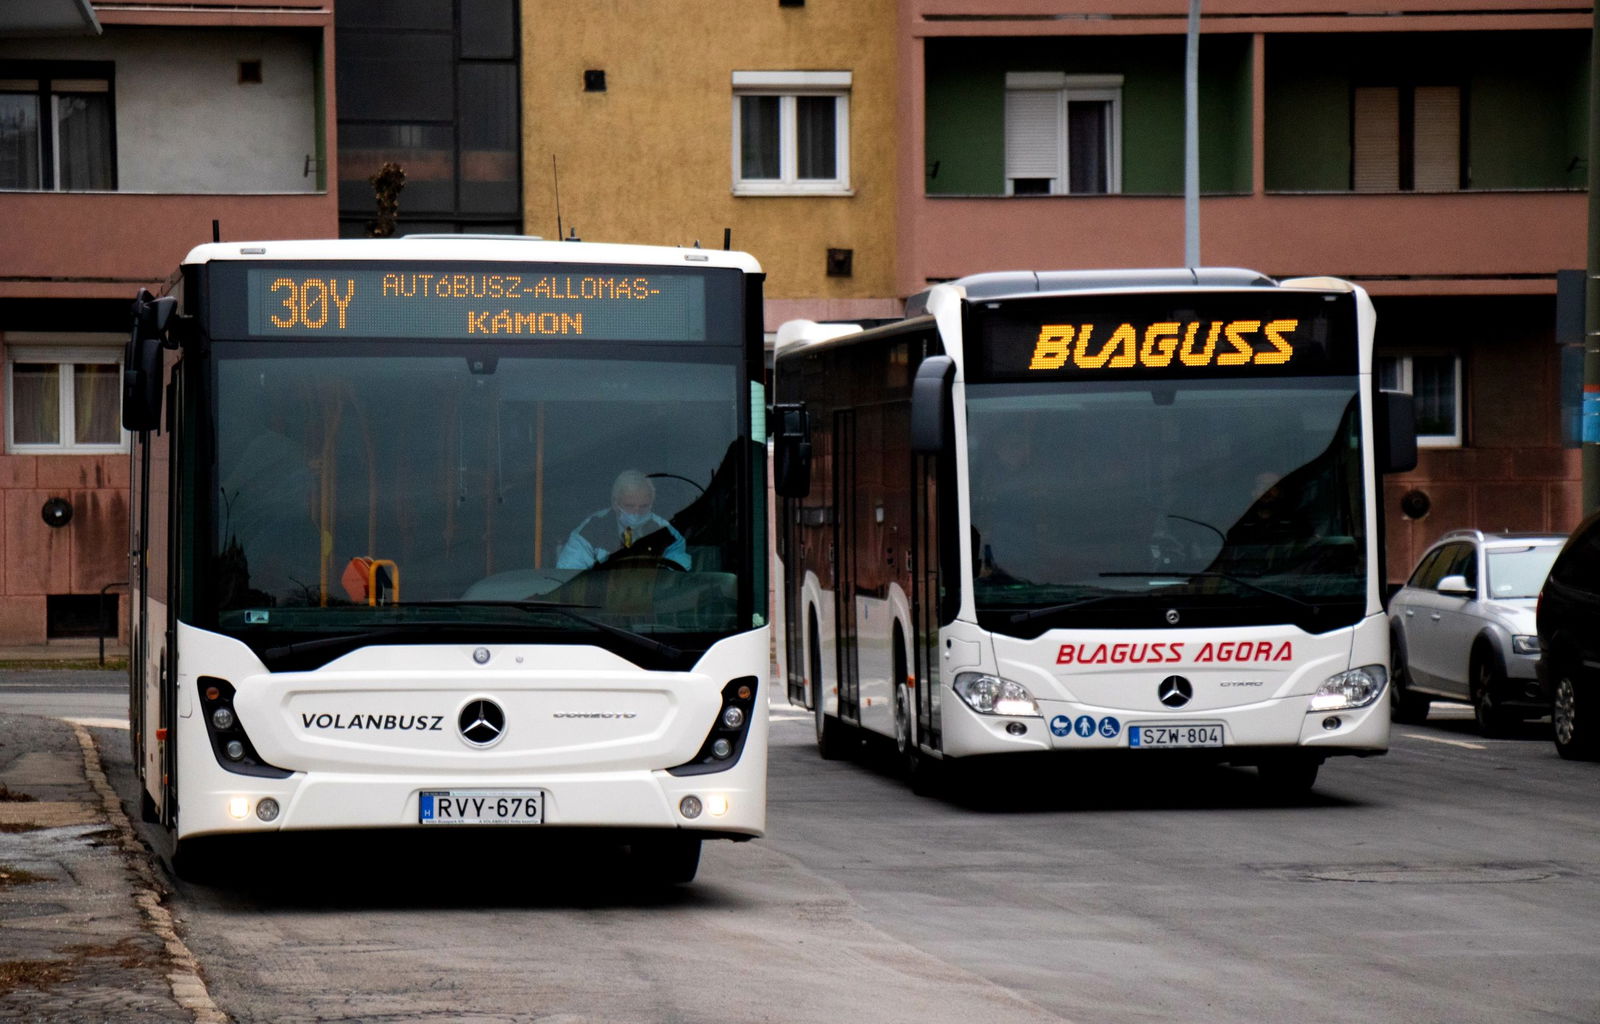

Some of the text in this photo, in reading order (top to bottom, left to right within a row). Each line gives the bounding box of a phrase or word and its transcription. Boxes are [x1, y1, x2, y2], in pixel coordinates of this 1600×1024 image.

[271, 278, 355, 329] 30Y
[468, 309, 583, 335] KÁMON
[1028, 319, 1298, 370] BLAGUSS
[1056, 641, 1293, 665] BLAGUSS AGORA
[301, 713, 445, 731] VOLÁNBUSZ
[1143, 728, 1218, 745] SZW-804
[438, 798, 537, 818] RVY-676
